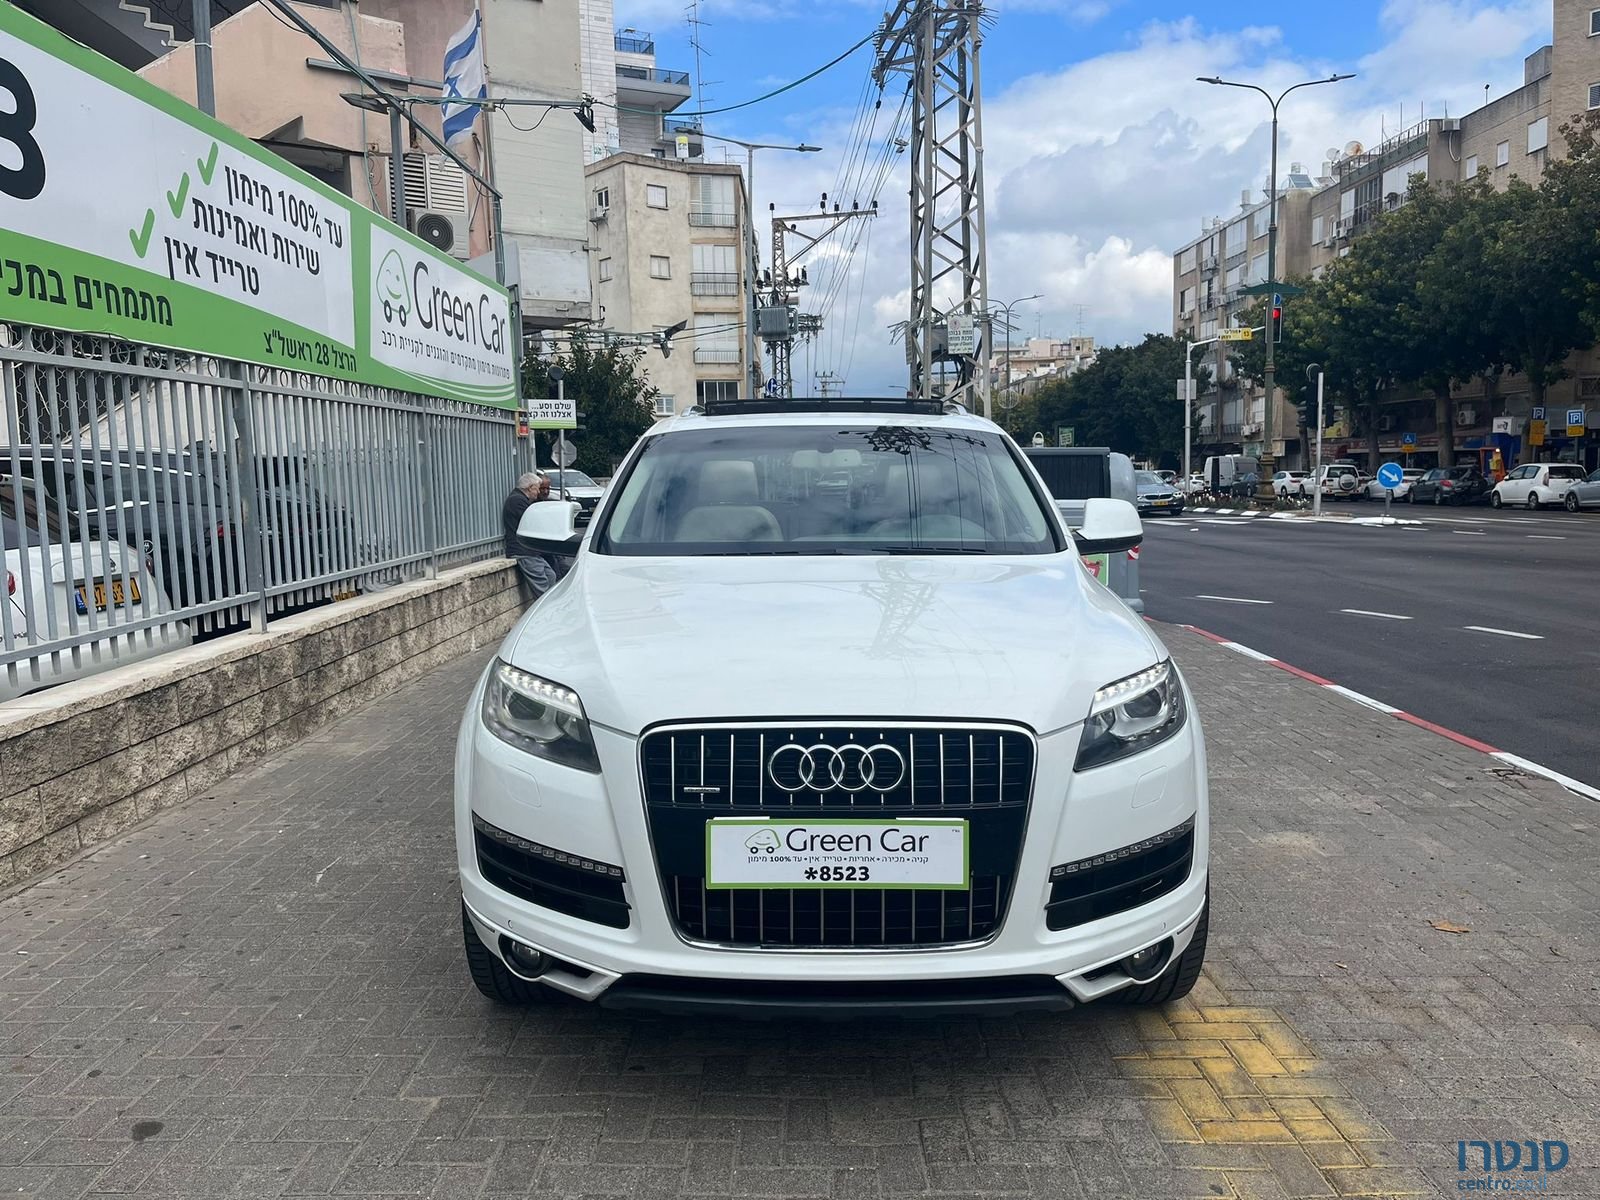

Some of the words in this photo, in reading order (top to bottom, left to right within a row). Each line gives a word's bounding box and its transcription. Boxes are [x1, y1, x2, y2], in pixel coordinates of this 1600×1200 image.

[225, 165, 274, 216] מימון
[192, 197, 268, 255] ואמינות
[278, 190, 321, 238] 100%
[324, 218, 343, 248] עד
[164, 236, 201, 280] אין
[272, 232, 320, 275] שירות
[205, 250, 260, 295] טרייד
[73, 274, 173, 327] מתמחים
[413, 261, 476, 345] Green
[479, 294, 506, 355] Car
[263, 329, 313, 363] ראשל"צ
[315, 341, 330, 366] 28
[382, 330, 396, 348] רכב
[399, 336, 423, 358] לקניית
[426, 344, 449, 362] והוגנים
[331, 344, 357, 373] הרצל
[450, 352, 476, 371] מתקדמים
[551, 410, 572, 418] אצלנו
[554, 402, 572, 410] שלם
[785, 828, 871, 852] Green
[880, 828, 929, 852] Car
[911, 856, 929, 864] קניה
